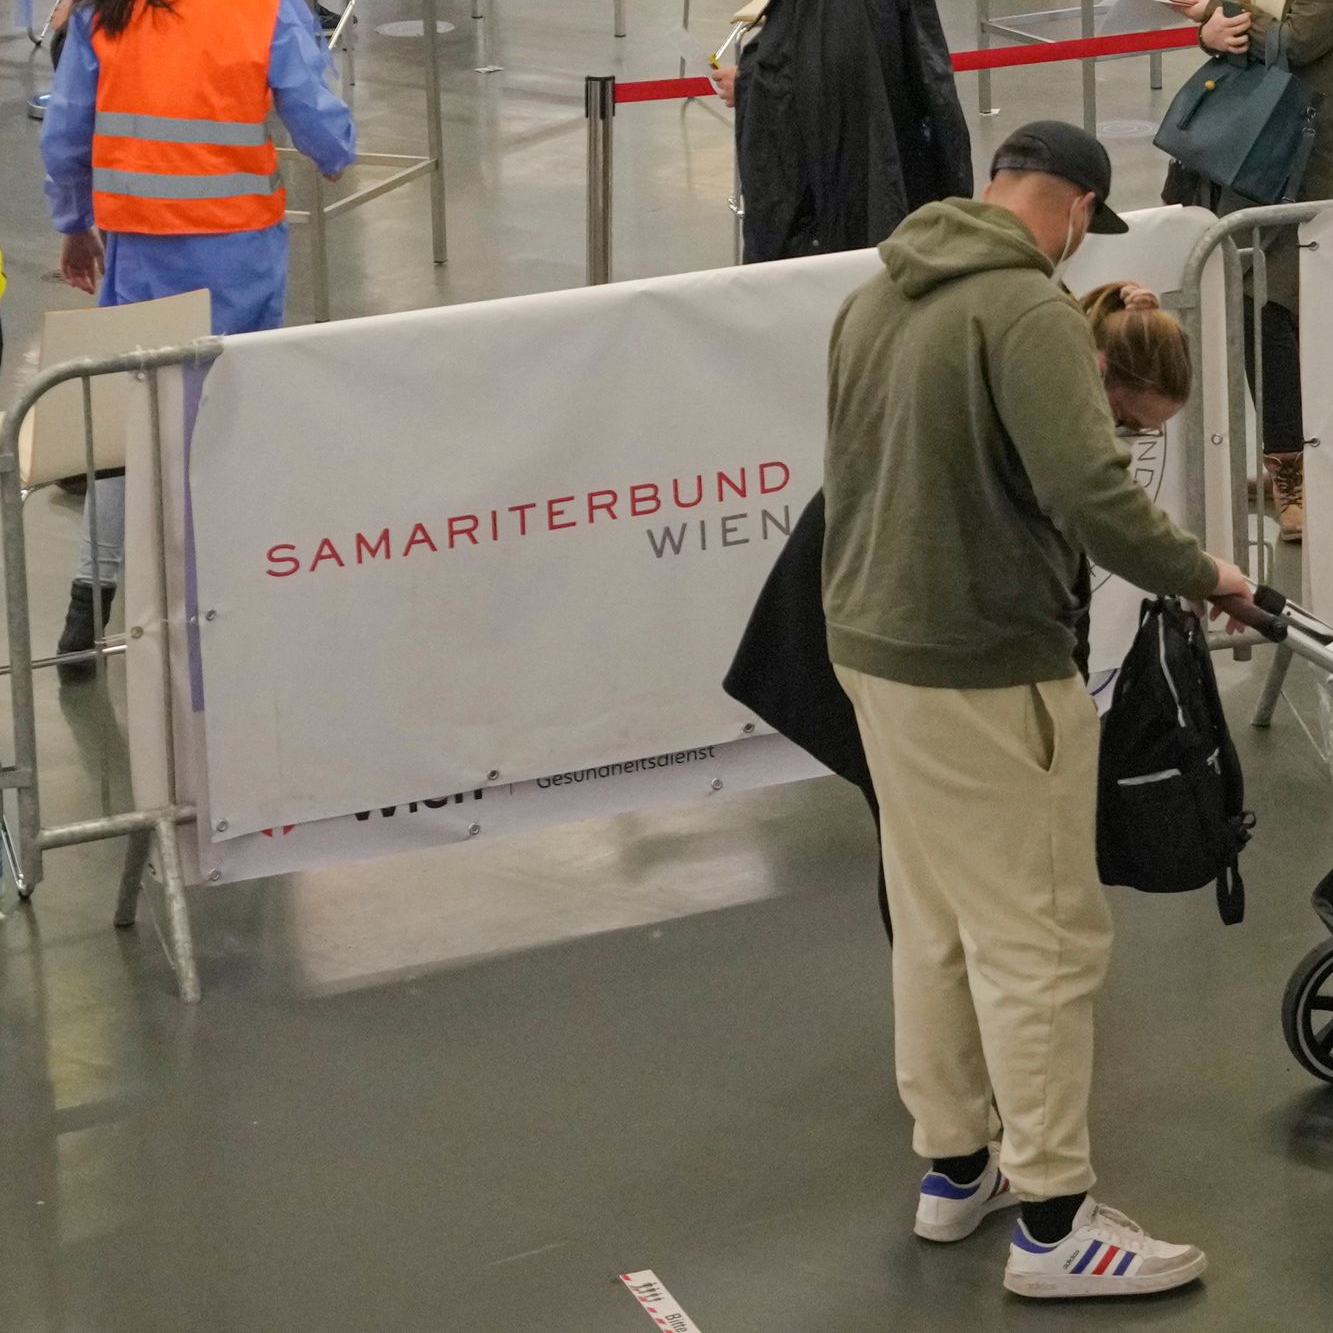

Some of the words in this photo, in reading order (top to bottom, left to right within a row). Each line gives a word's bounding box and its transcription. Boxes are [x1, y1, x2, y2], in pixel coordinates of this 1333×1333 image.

[266, 460, 791, 578] SAMARITERBUND
[646, 504, 792, 559] WIEN
[665, 1312, 688, 1333] Bitte
